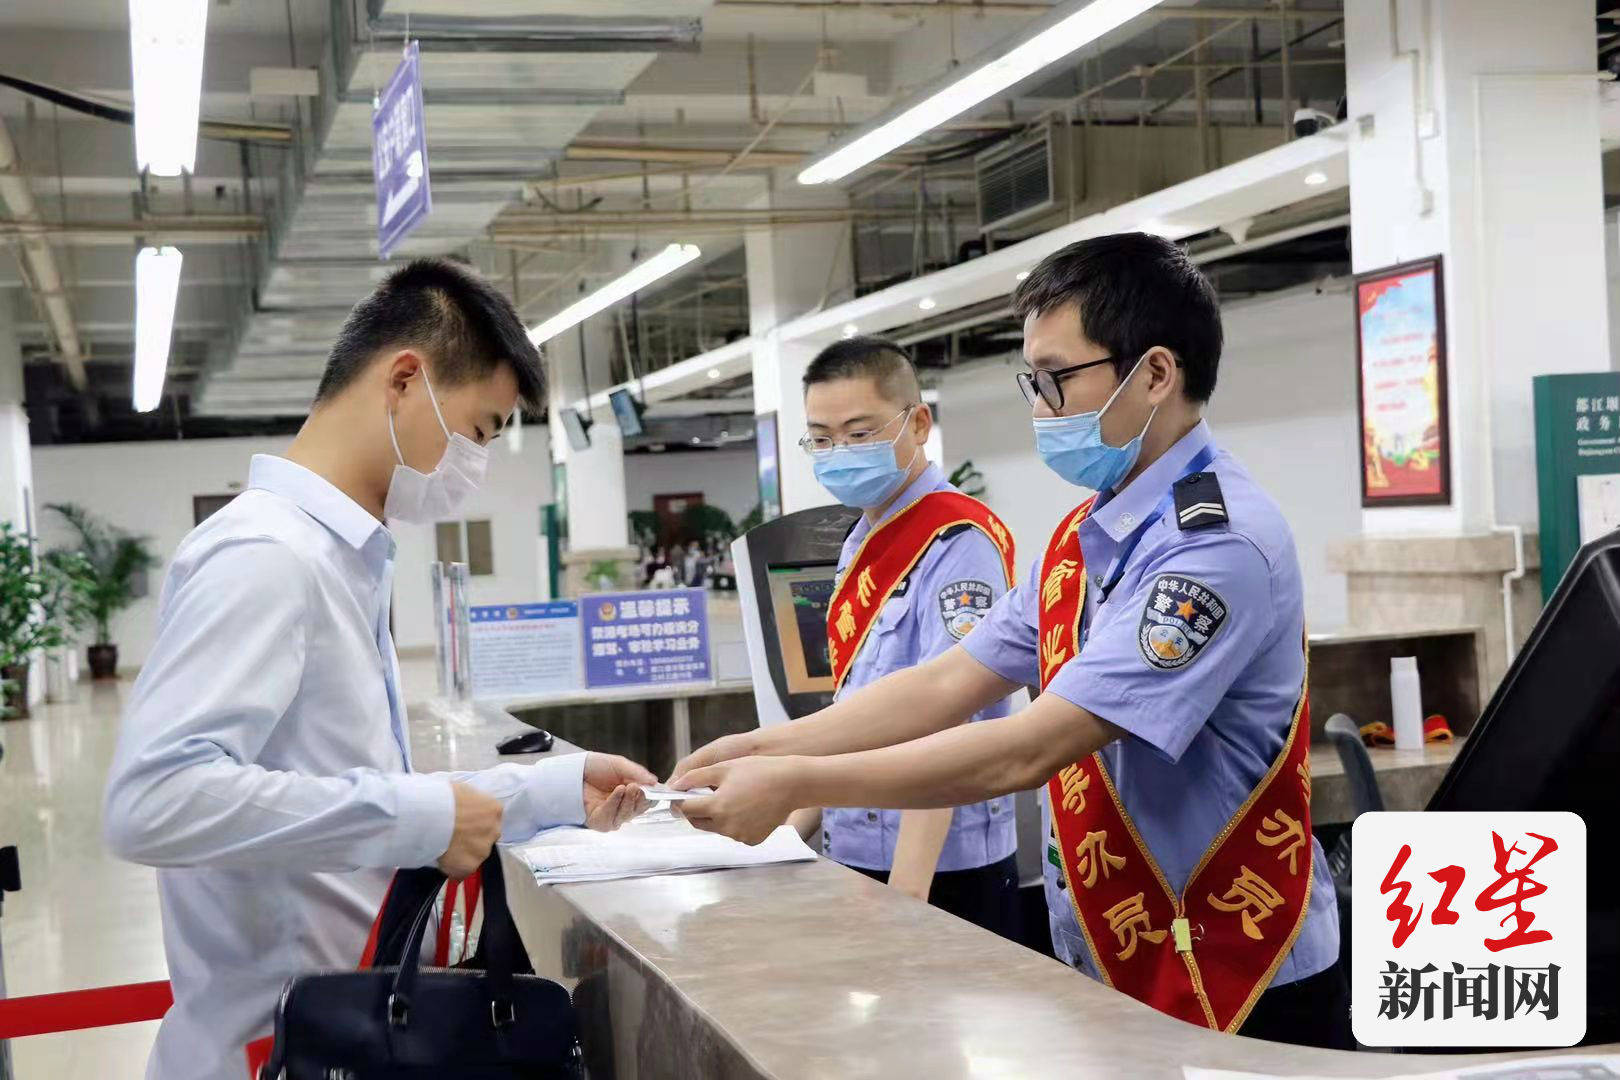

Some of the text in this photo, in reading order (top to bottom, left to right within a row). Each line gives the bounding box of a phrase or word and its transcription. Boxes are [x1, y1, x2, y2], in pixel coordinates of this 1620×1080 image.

[1575, 415, 1620, 432] 政务
[1157, 579, 1225, 620] 中华人民共和国
